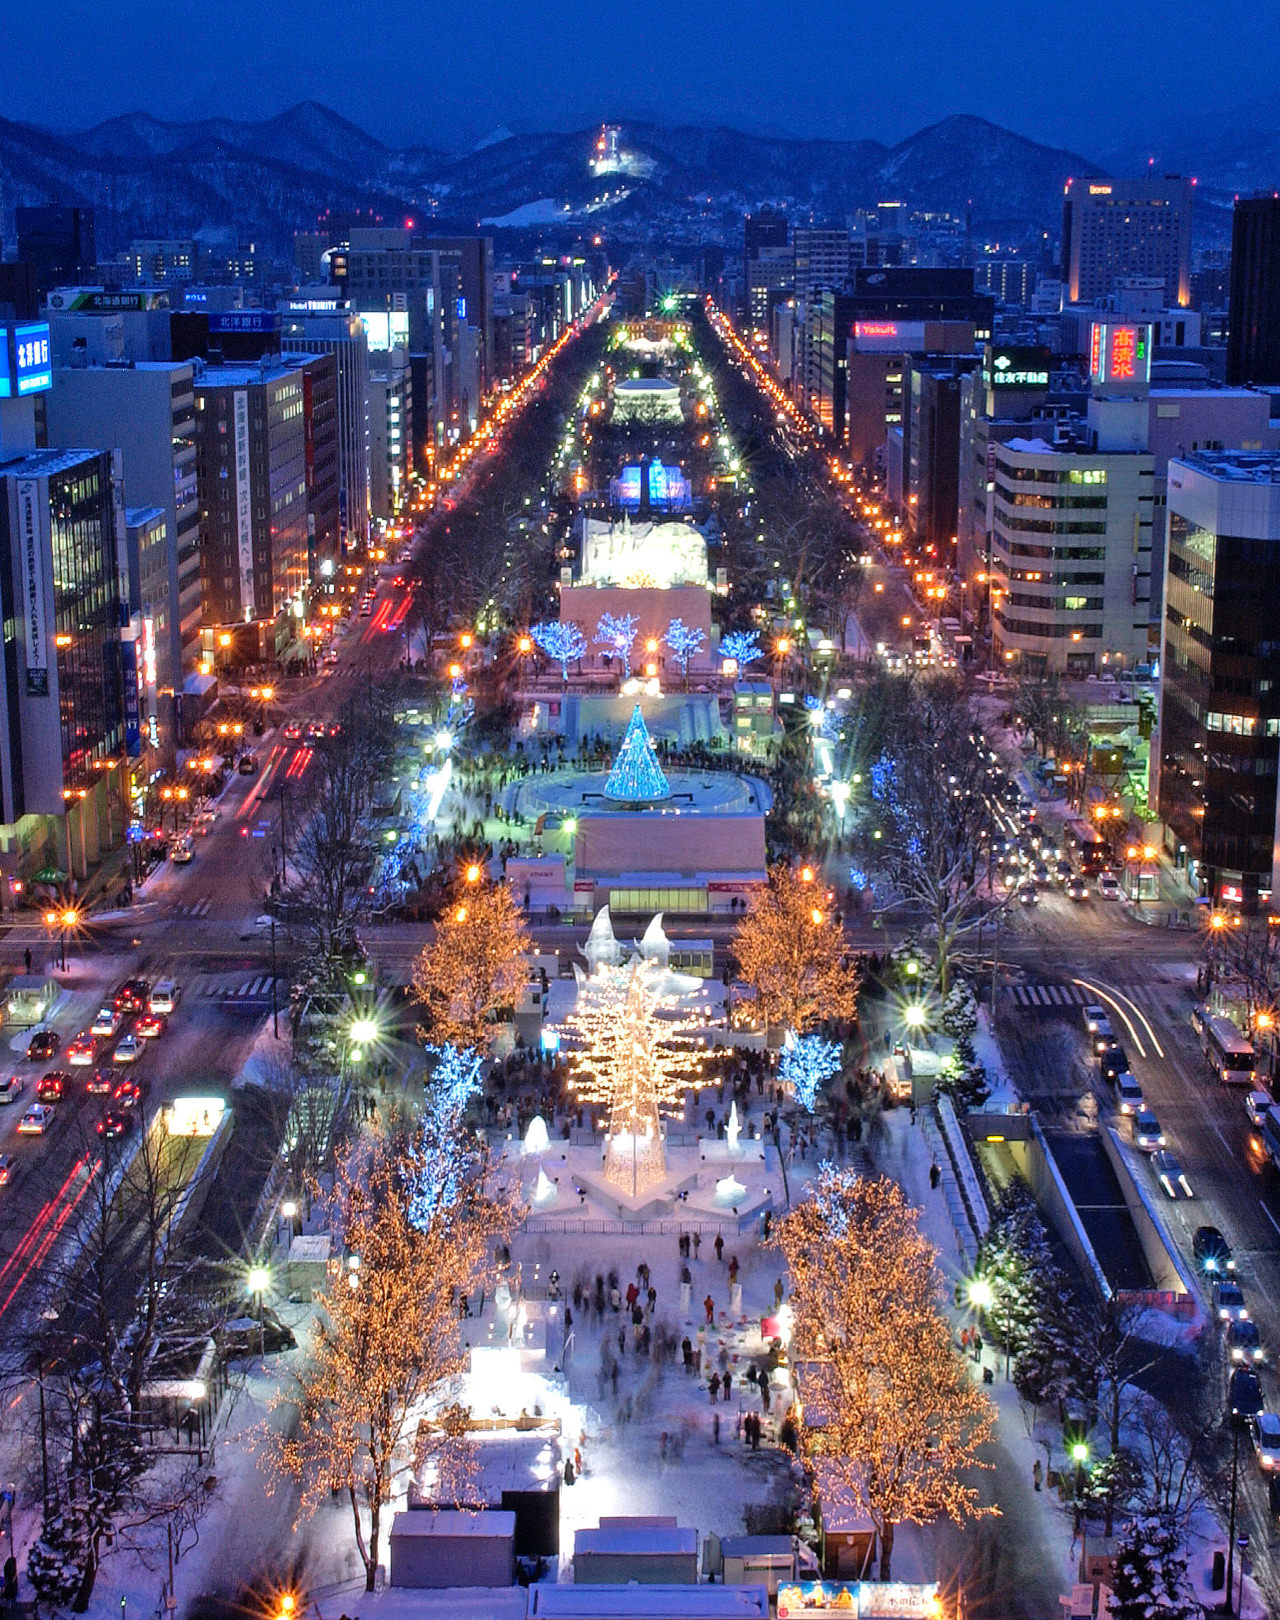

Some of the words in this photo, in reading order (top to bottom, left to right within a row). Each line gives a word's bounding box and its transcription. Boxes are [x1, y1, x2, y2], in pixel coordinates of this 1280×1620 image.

[220, 316, 262, 328] 北洋銀行
[863, 323, 897, 336] Yakult
[994, 371, 1048, 384] 住友不動産
